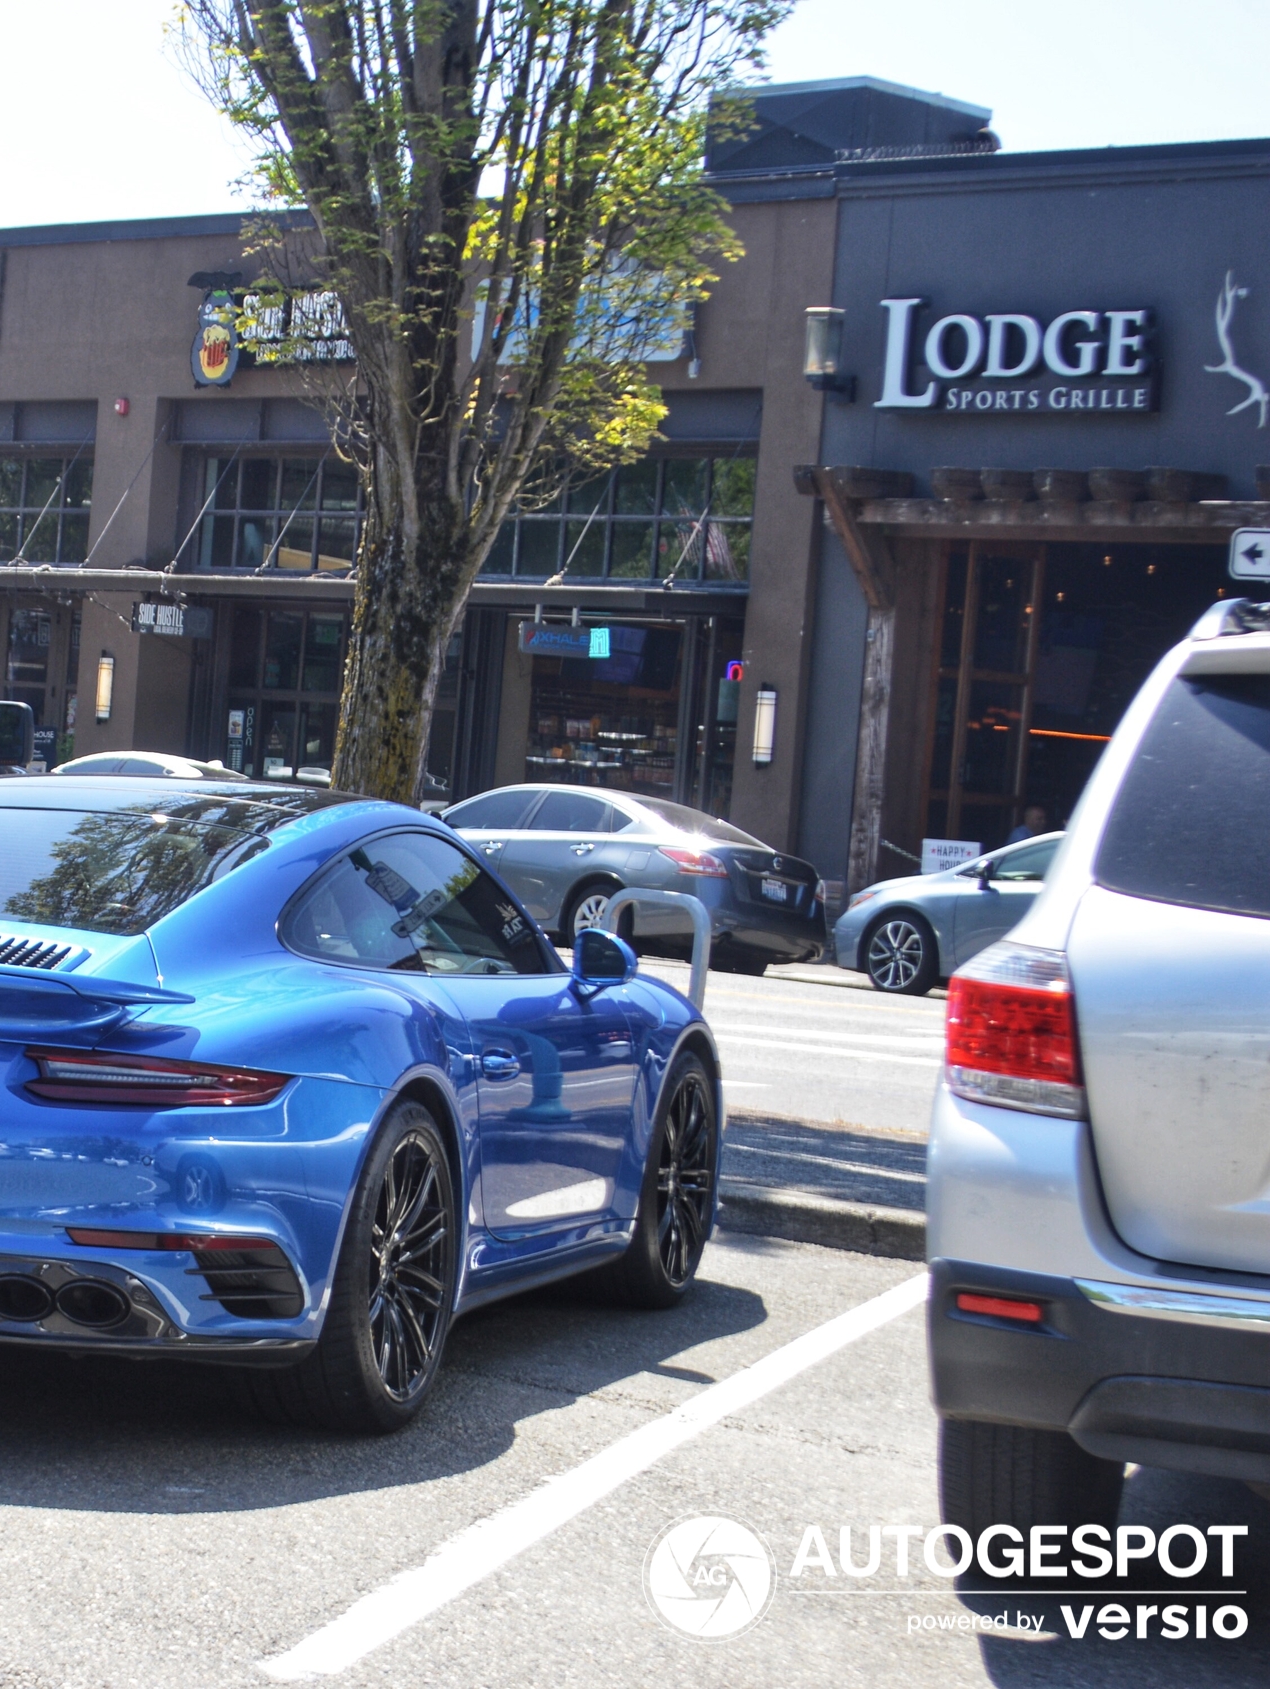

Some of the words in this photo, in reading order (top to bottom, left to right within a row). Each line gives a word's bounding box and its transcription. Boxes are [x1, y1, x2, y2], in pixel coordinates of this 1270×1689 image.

[873, 298, 1148, 408] LODGE
[946, 387, 1040, 410] SPORTS
[1048, 386, 1148, 410] GRILLE
[138, 603, 157, 625] SIDE
[157, 604, 184, 627] HUSTLE
[936, 845, 966, 858] HAPPY
